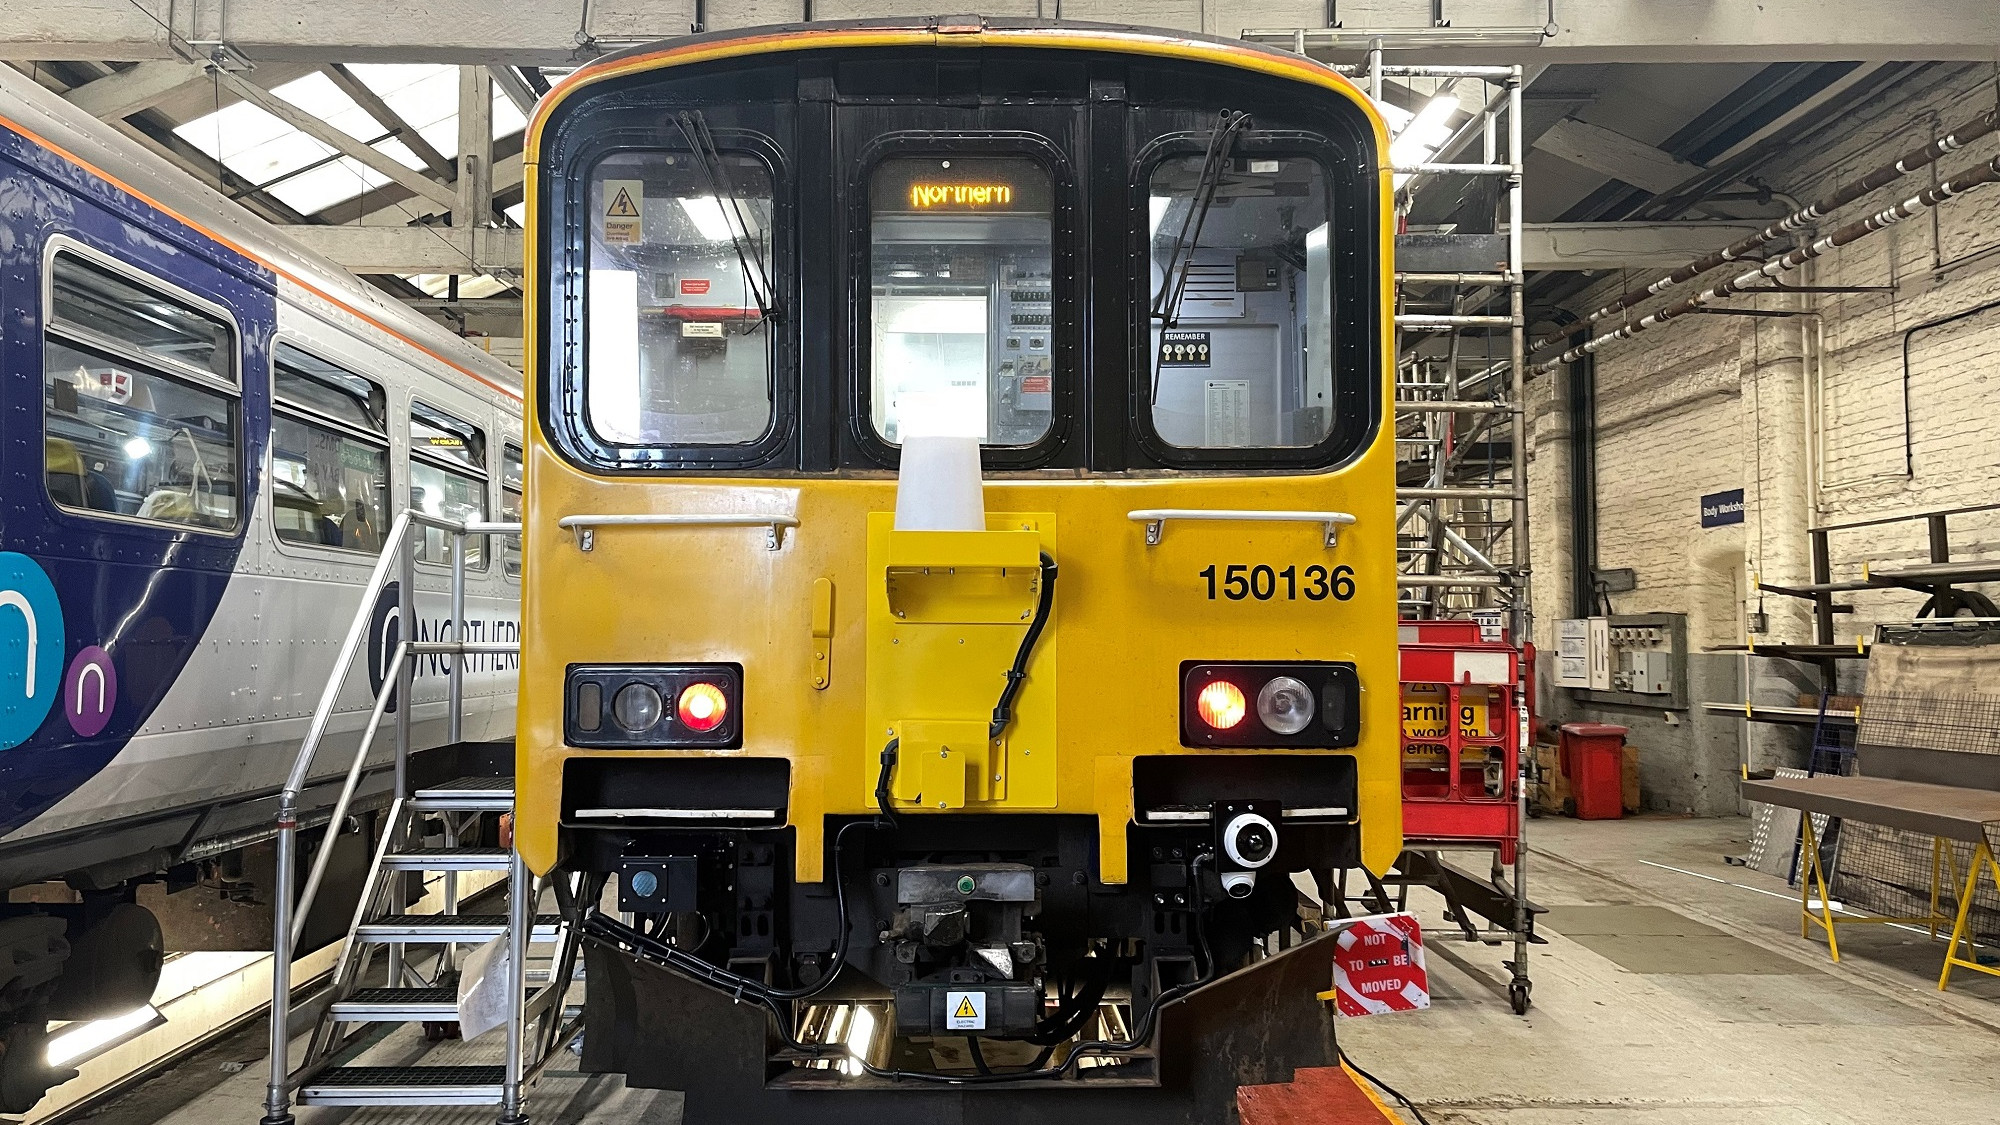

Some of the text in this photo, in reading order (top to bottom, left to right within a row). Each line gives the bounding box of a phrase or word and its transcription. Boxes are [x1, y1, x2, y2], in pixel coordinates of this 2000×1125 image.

[606, 222, 633, 231] Danger
[1704, 506, 1718, 517] Body
[1199, 564, 1356, 601] 150136
[1402, 702, 1475, 726] arnig
[1412, 725, 1479, 738] worng
[1364, 933, 1386, 946] NOT
[1349, 960, 1364, 972] TO
[1393, 954, 1407, 966] BE
[1361, 979, 1401, 993] MOVED
